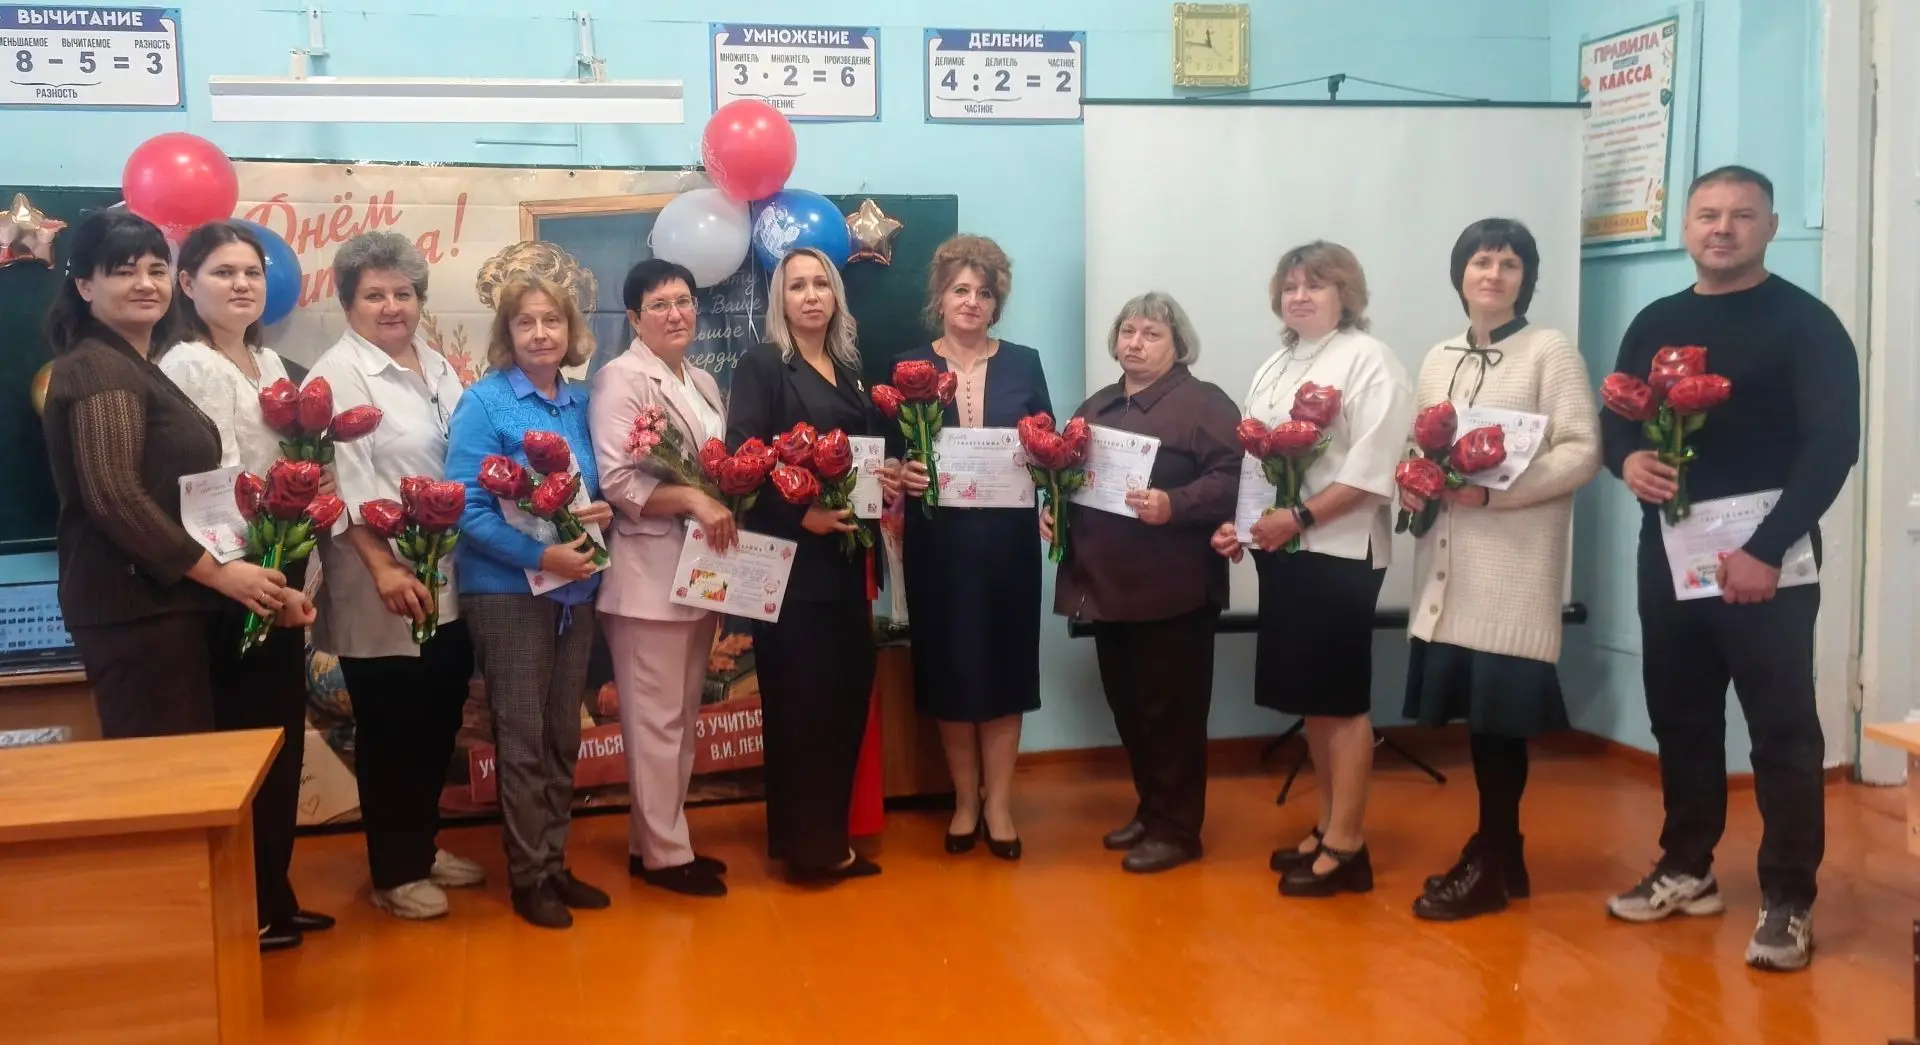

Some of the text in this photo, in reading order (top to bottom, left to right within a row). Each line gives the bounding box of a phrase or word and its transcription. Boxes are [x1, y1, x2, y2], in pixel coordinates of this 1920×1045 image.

[17, 9, 144, 27] ВЫЧИТАНИЕ
[0, 37, 171, 49] ЕНЬШАЕМОЕ ВЫЧИТАЕМОЕ РАЗНОСТЬ
[743, 28, 850, 45] УМНОЖЕНИЕ
[968, 32, 1044, 48] ДЕЛЕНИЕ
[1594, 31, 1660, 64] ПРАВИЛА
[16, 50, 33, 72] 8
[80, 51, 96, 73] 5
[114, 56, 129, 69] =
[146, 52, 163, 74] 3
[720, 53, 872, 66] МНОЖИТЕЛЬ МНОЖИТЕЛЬ ПРОИЗВЕДЕНИЕ
[934, 57, 1075, 68] ДЕЛИМОЕ ДЕЛИТЕЛЬ ЧАСТНОЕ
[733, 64, 749, 85] 3
[783, 65, 798, 86] 2
[813, 70, 827, 82] =
[840, 66, 856, 87] 6
[941, 69, 958, 91] 4
[994, 70, 1011, 92] 2
[1026, 75, 1041, 88] =
[1056, 70, 1072, 93] 2
[1599, 63, 1653, 92] КЛАССА
[36, 88, 78, 98] РАЗНОСТЬ
[964, 104, 994, 114] ЧАСТНОЕ
[711, 293, 762, 314] Ваше
[686, 349, 747, 373] сердц
[578, 734, 625, 760] ИТЬСЯ
[708, 709, 763, 736] УЧИТЬС
[711, 733, 764, 761] В.И. ЛЕН
